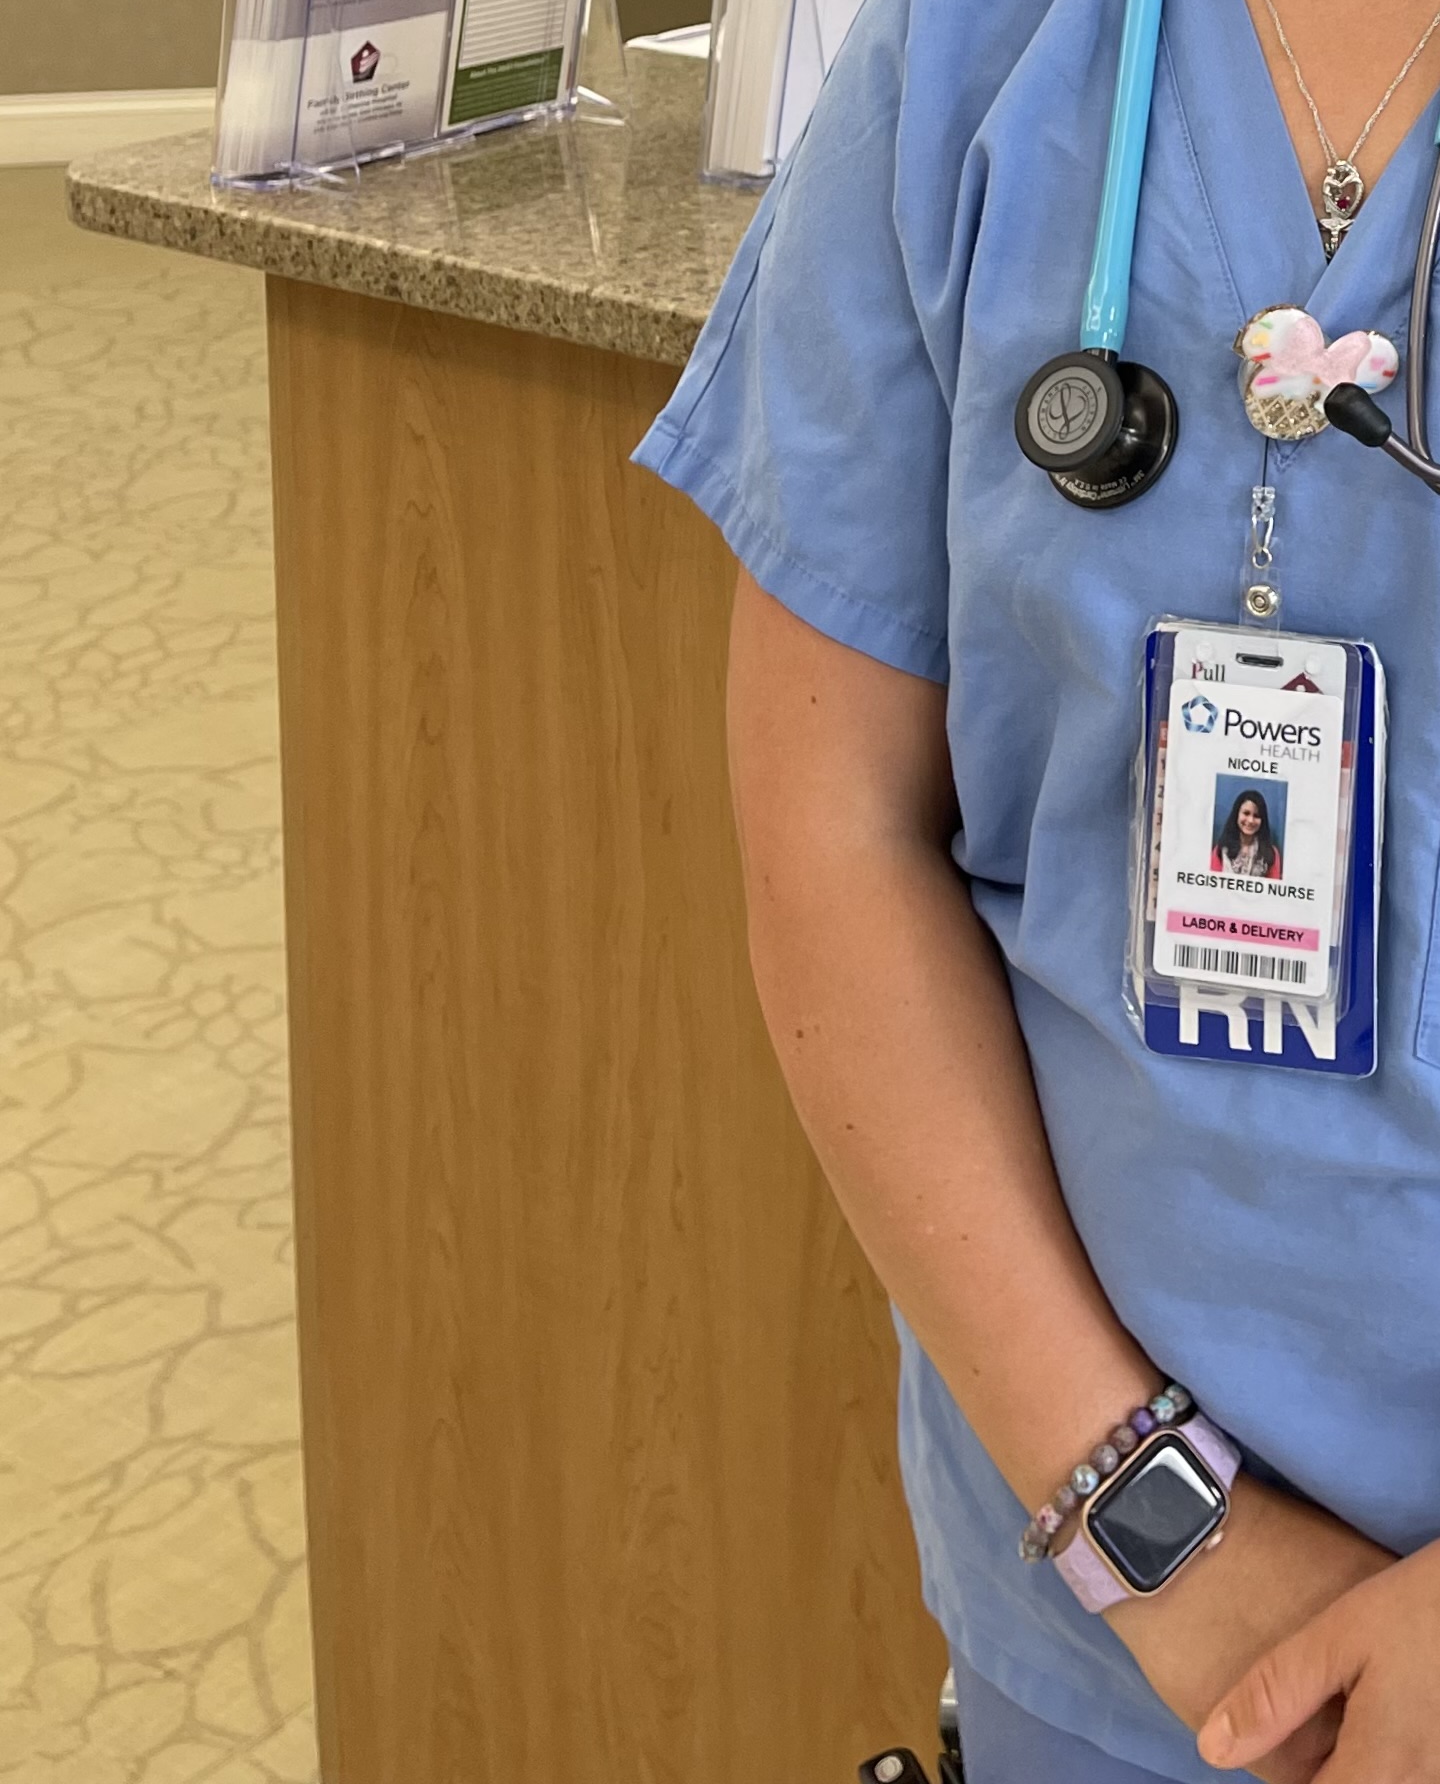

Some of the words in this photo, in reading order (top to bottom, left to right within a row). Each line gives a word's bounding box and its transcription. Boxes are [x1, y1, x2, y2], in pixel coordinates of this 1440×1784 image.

[1191, 659, 1226, 683] Pull
[1224, 708, 1321, 747] Powers
[1227, 757, 1279, 775] NICOLE
[1260, 744, 1321, 763] HEALTH
[1177, 871, 1264, 894] REGISTERED
[1267, 883, 1315, 901] NURSE
[1182, 916, 1226, 933] LABOR
[1229, 922, 1238, 934] &
[1241, 923, 1304, 943] DELIVERY
[1179, 979, 1337, 1061] RN
